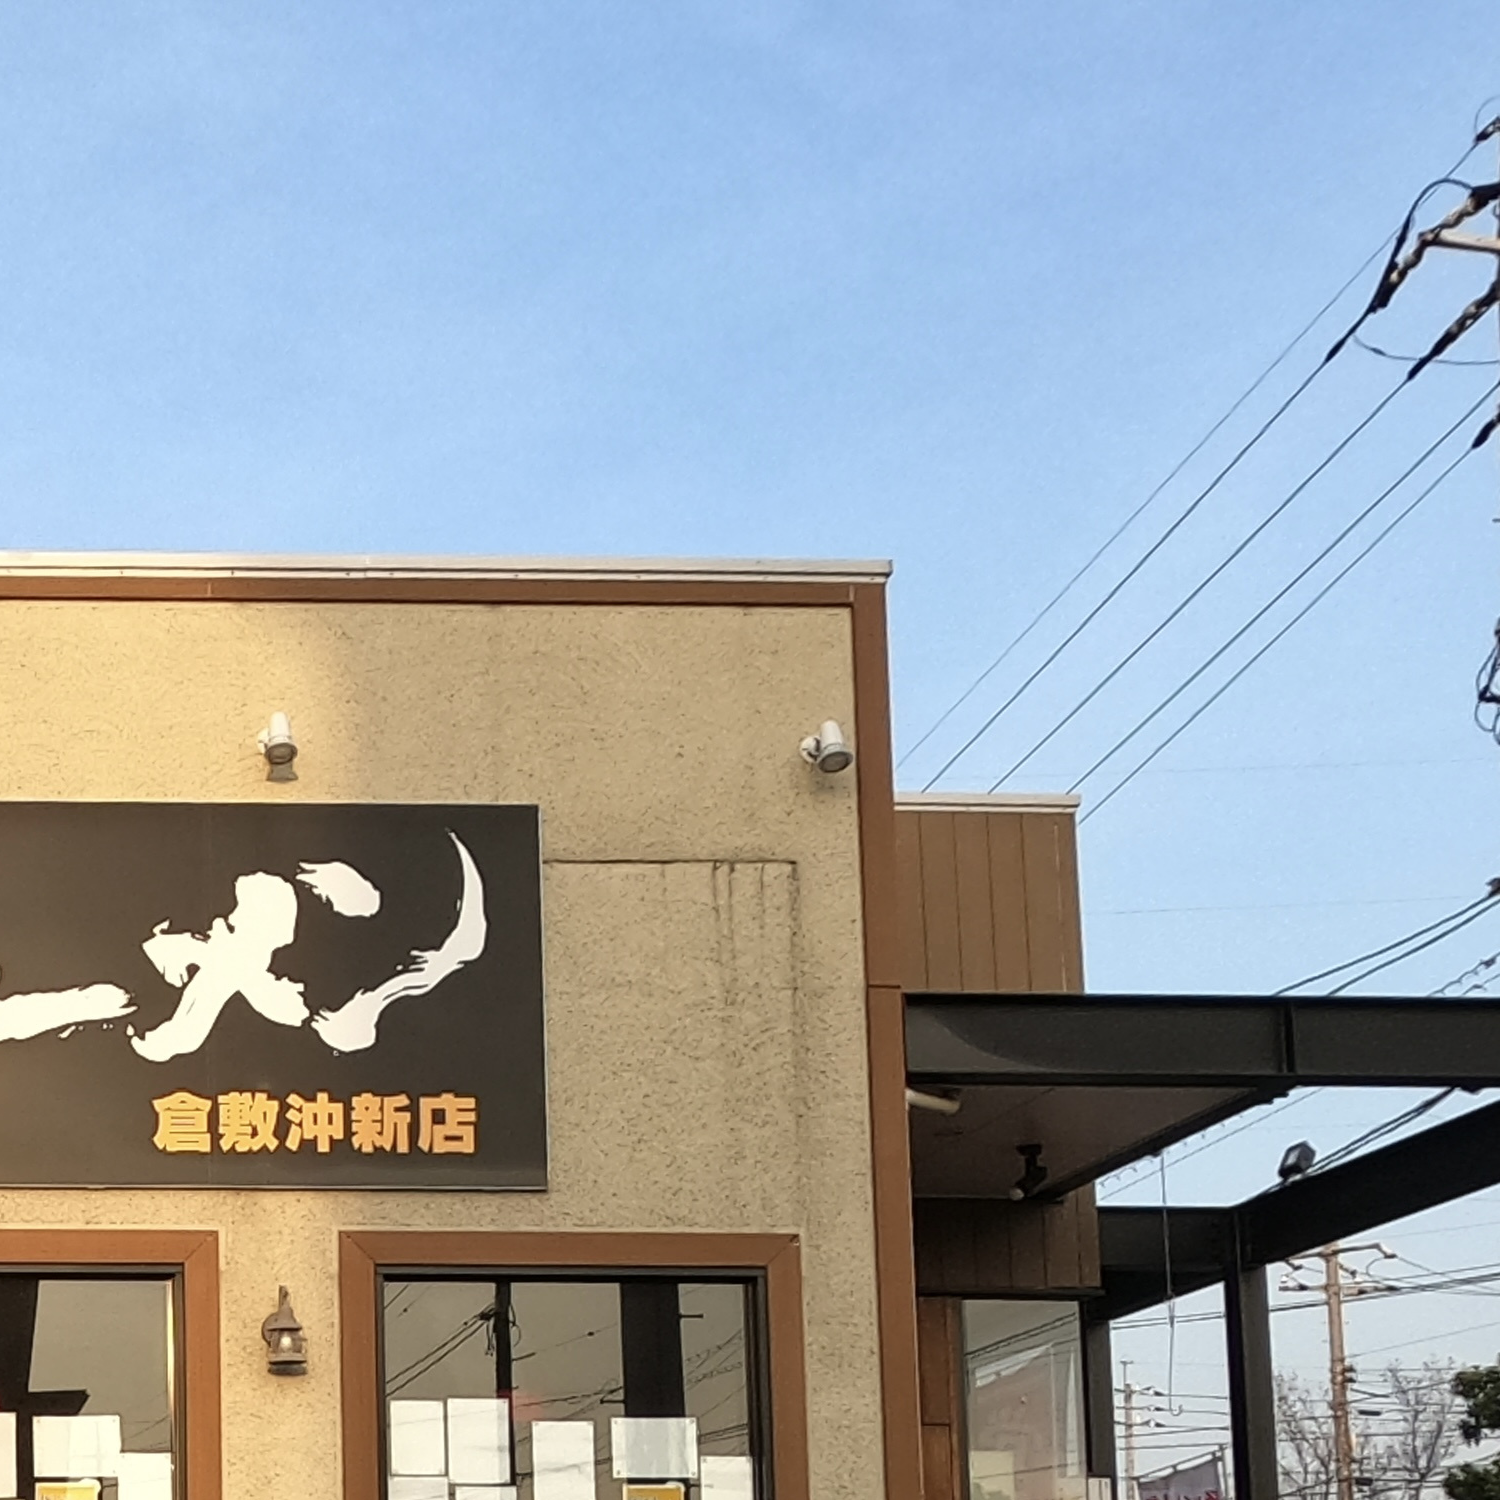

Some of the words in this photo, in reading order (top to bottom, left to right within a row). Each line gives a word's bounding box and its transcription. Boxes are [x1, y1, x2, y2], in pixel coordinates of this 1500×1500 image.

[152, 1091, 477, 1154] 倉敷沖新店
